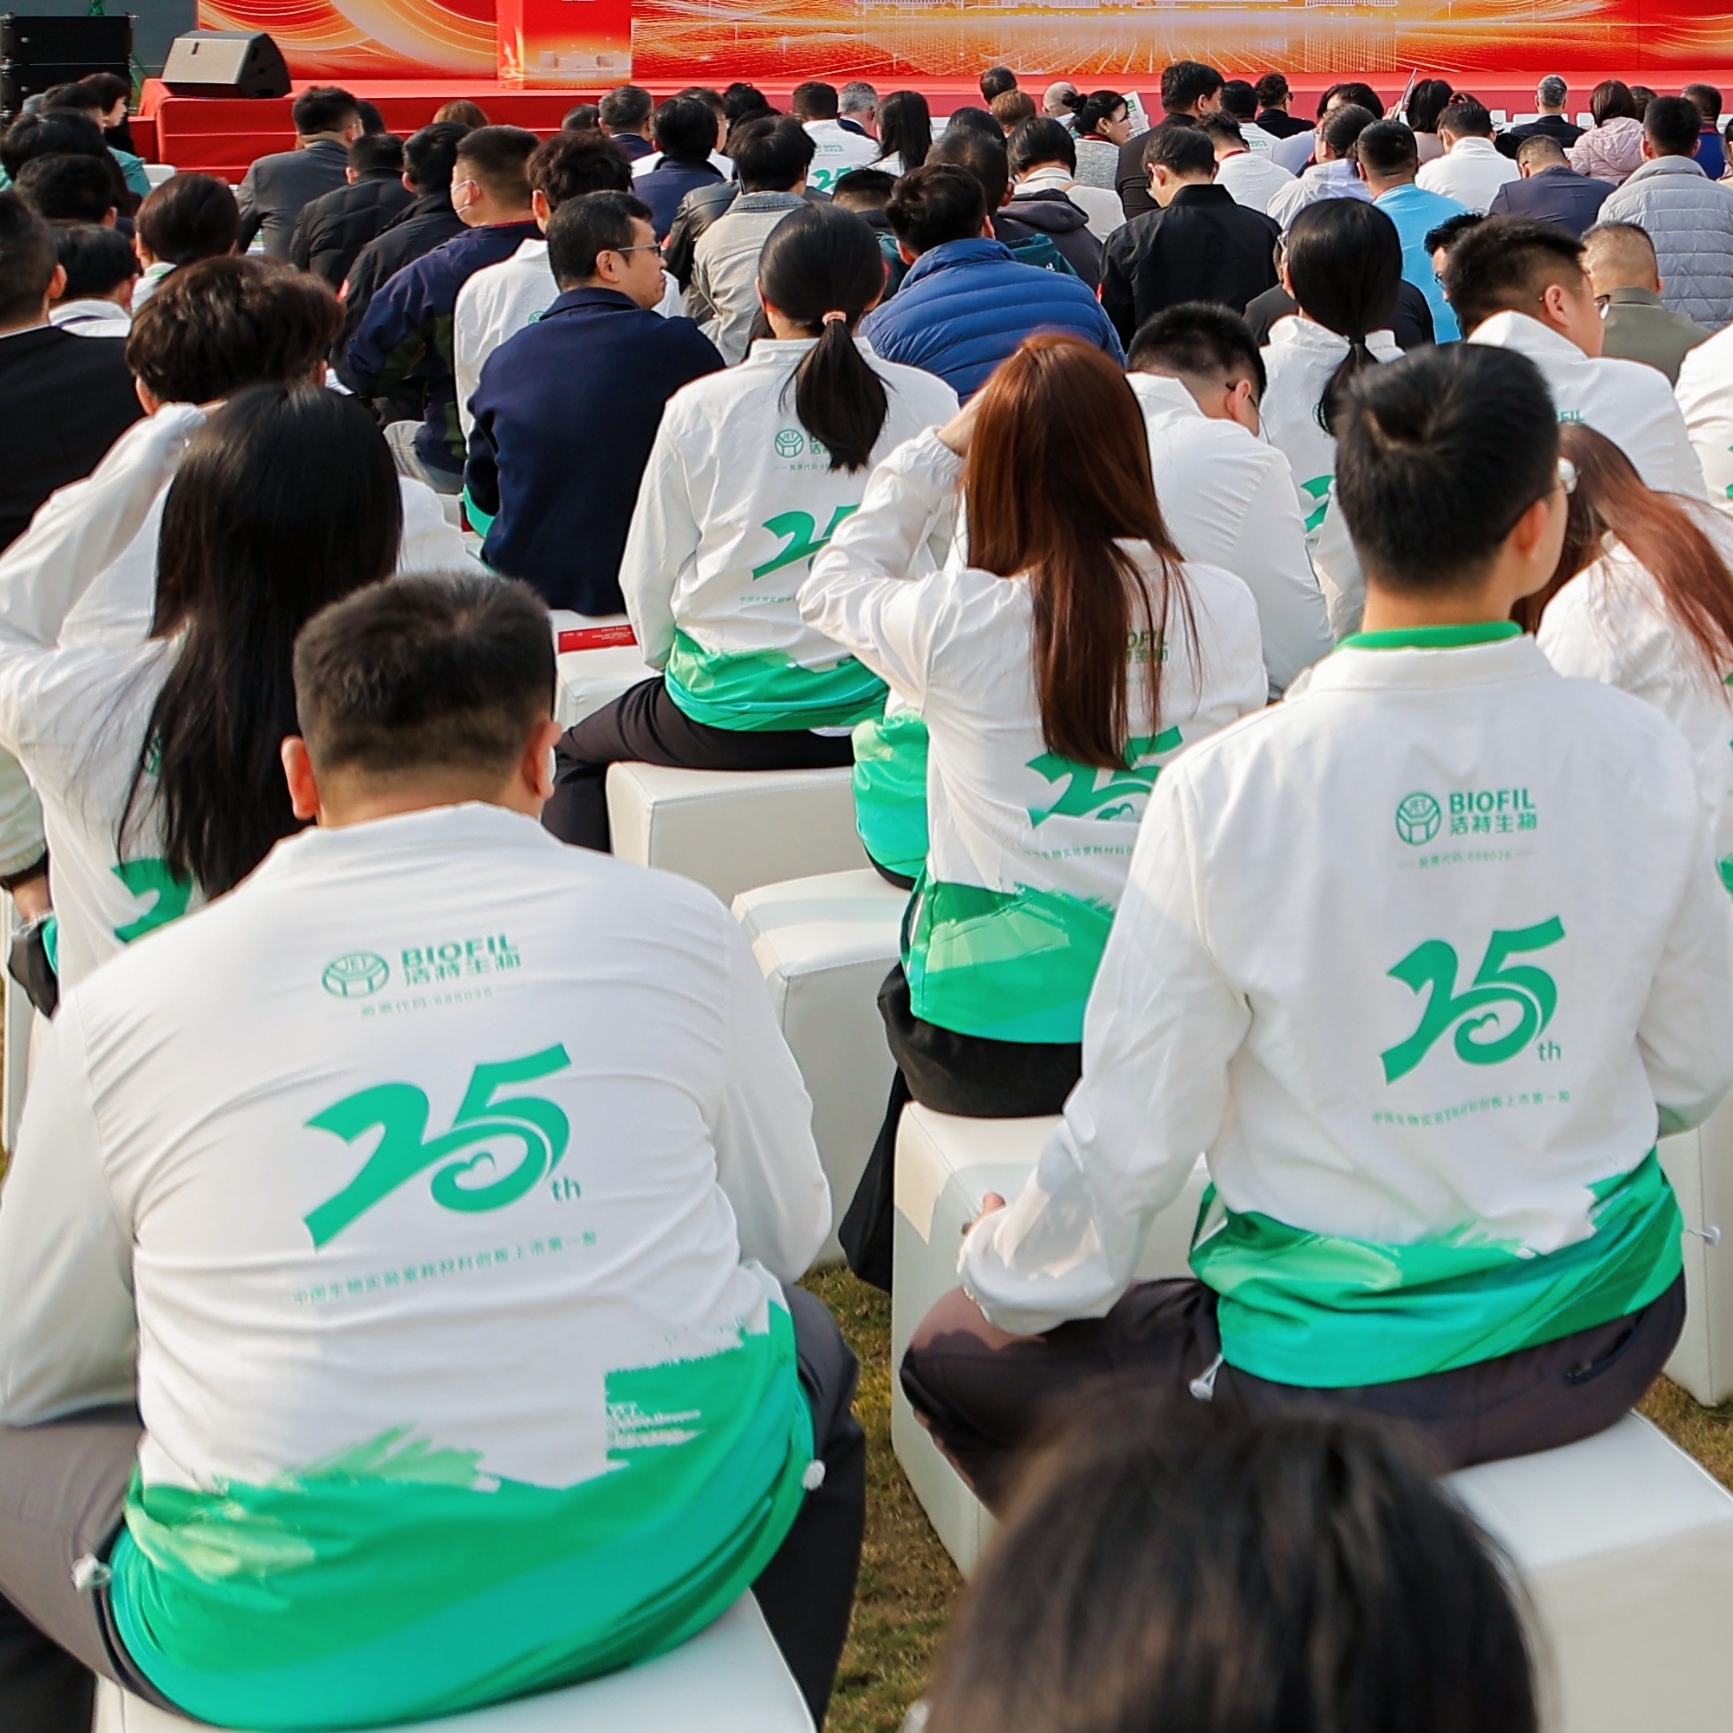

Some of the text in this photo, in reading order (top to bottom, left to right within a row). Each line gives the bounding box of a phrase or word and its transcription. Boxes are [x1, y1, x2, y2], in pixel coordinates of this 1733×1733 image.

[1449, 787, 1537, 815] BIOFIL
[1449, 810, 1538, 836] 洁特生物
[400, 934, 520, 969] BIOFIL
[403, 954, 522, 987] 洁特生物
